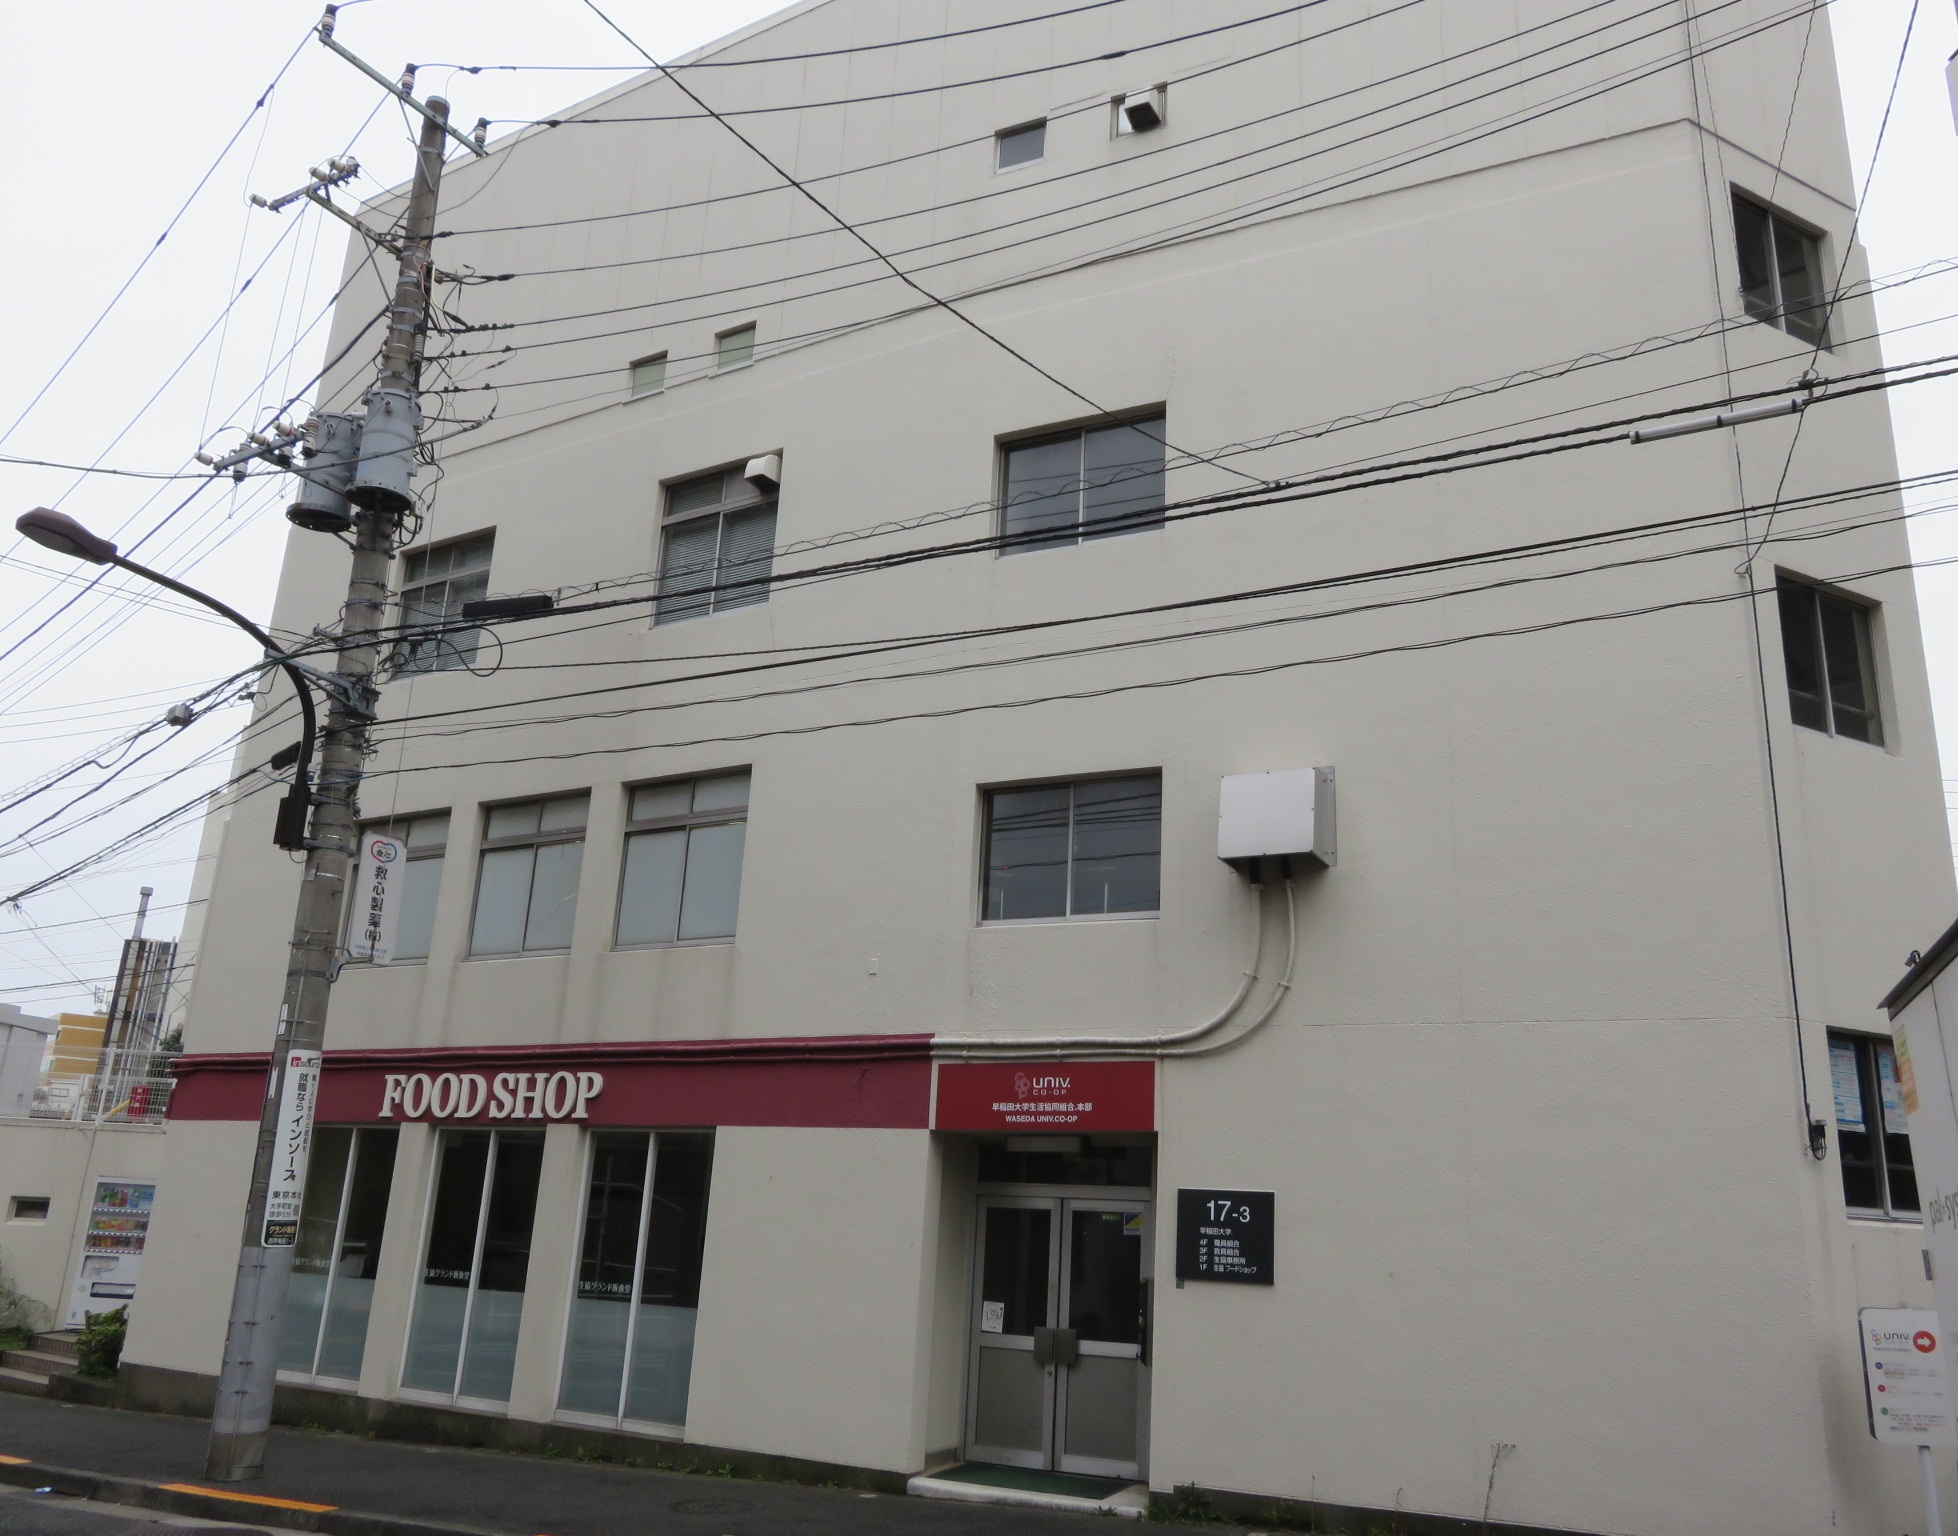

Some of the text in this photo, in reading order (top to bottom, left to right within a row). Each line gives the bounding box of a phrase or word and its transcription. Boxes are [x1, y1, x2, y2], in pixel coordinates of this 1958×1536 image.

[379, 1071, 604, 1119] FOOD SHOP
[1206, 1200, 1250, 1223] 17-3
[1200, 1227, 1232, 1236] 早稲田大学
[1199, 1255, 1208, 1263] 2F
